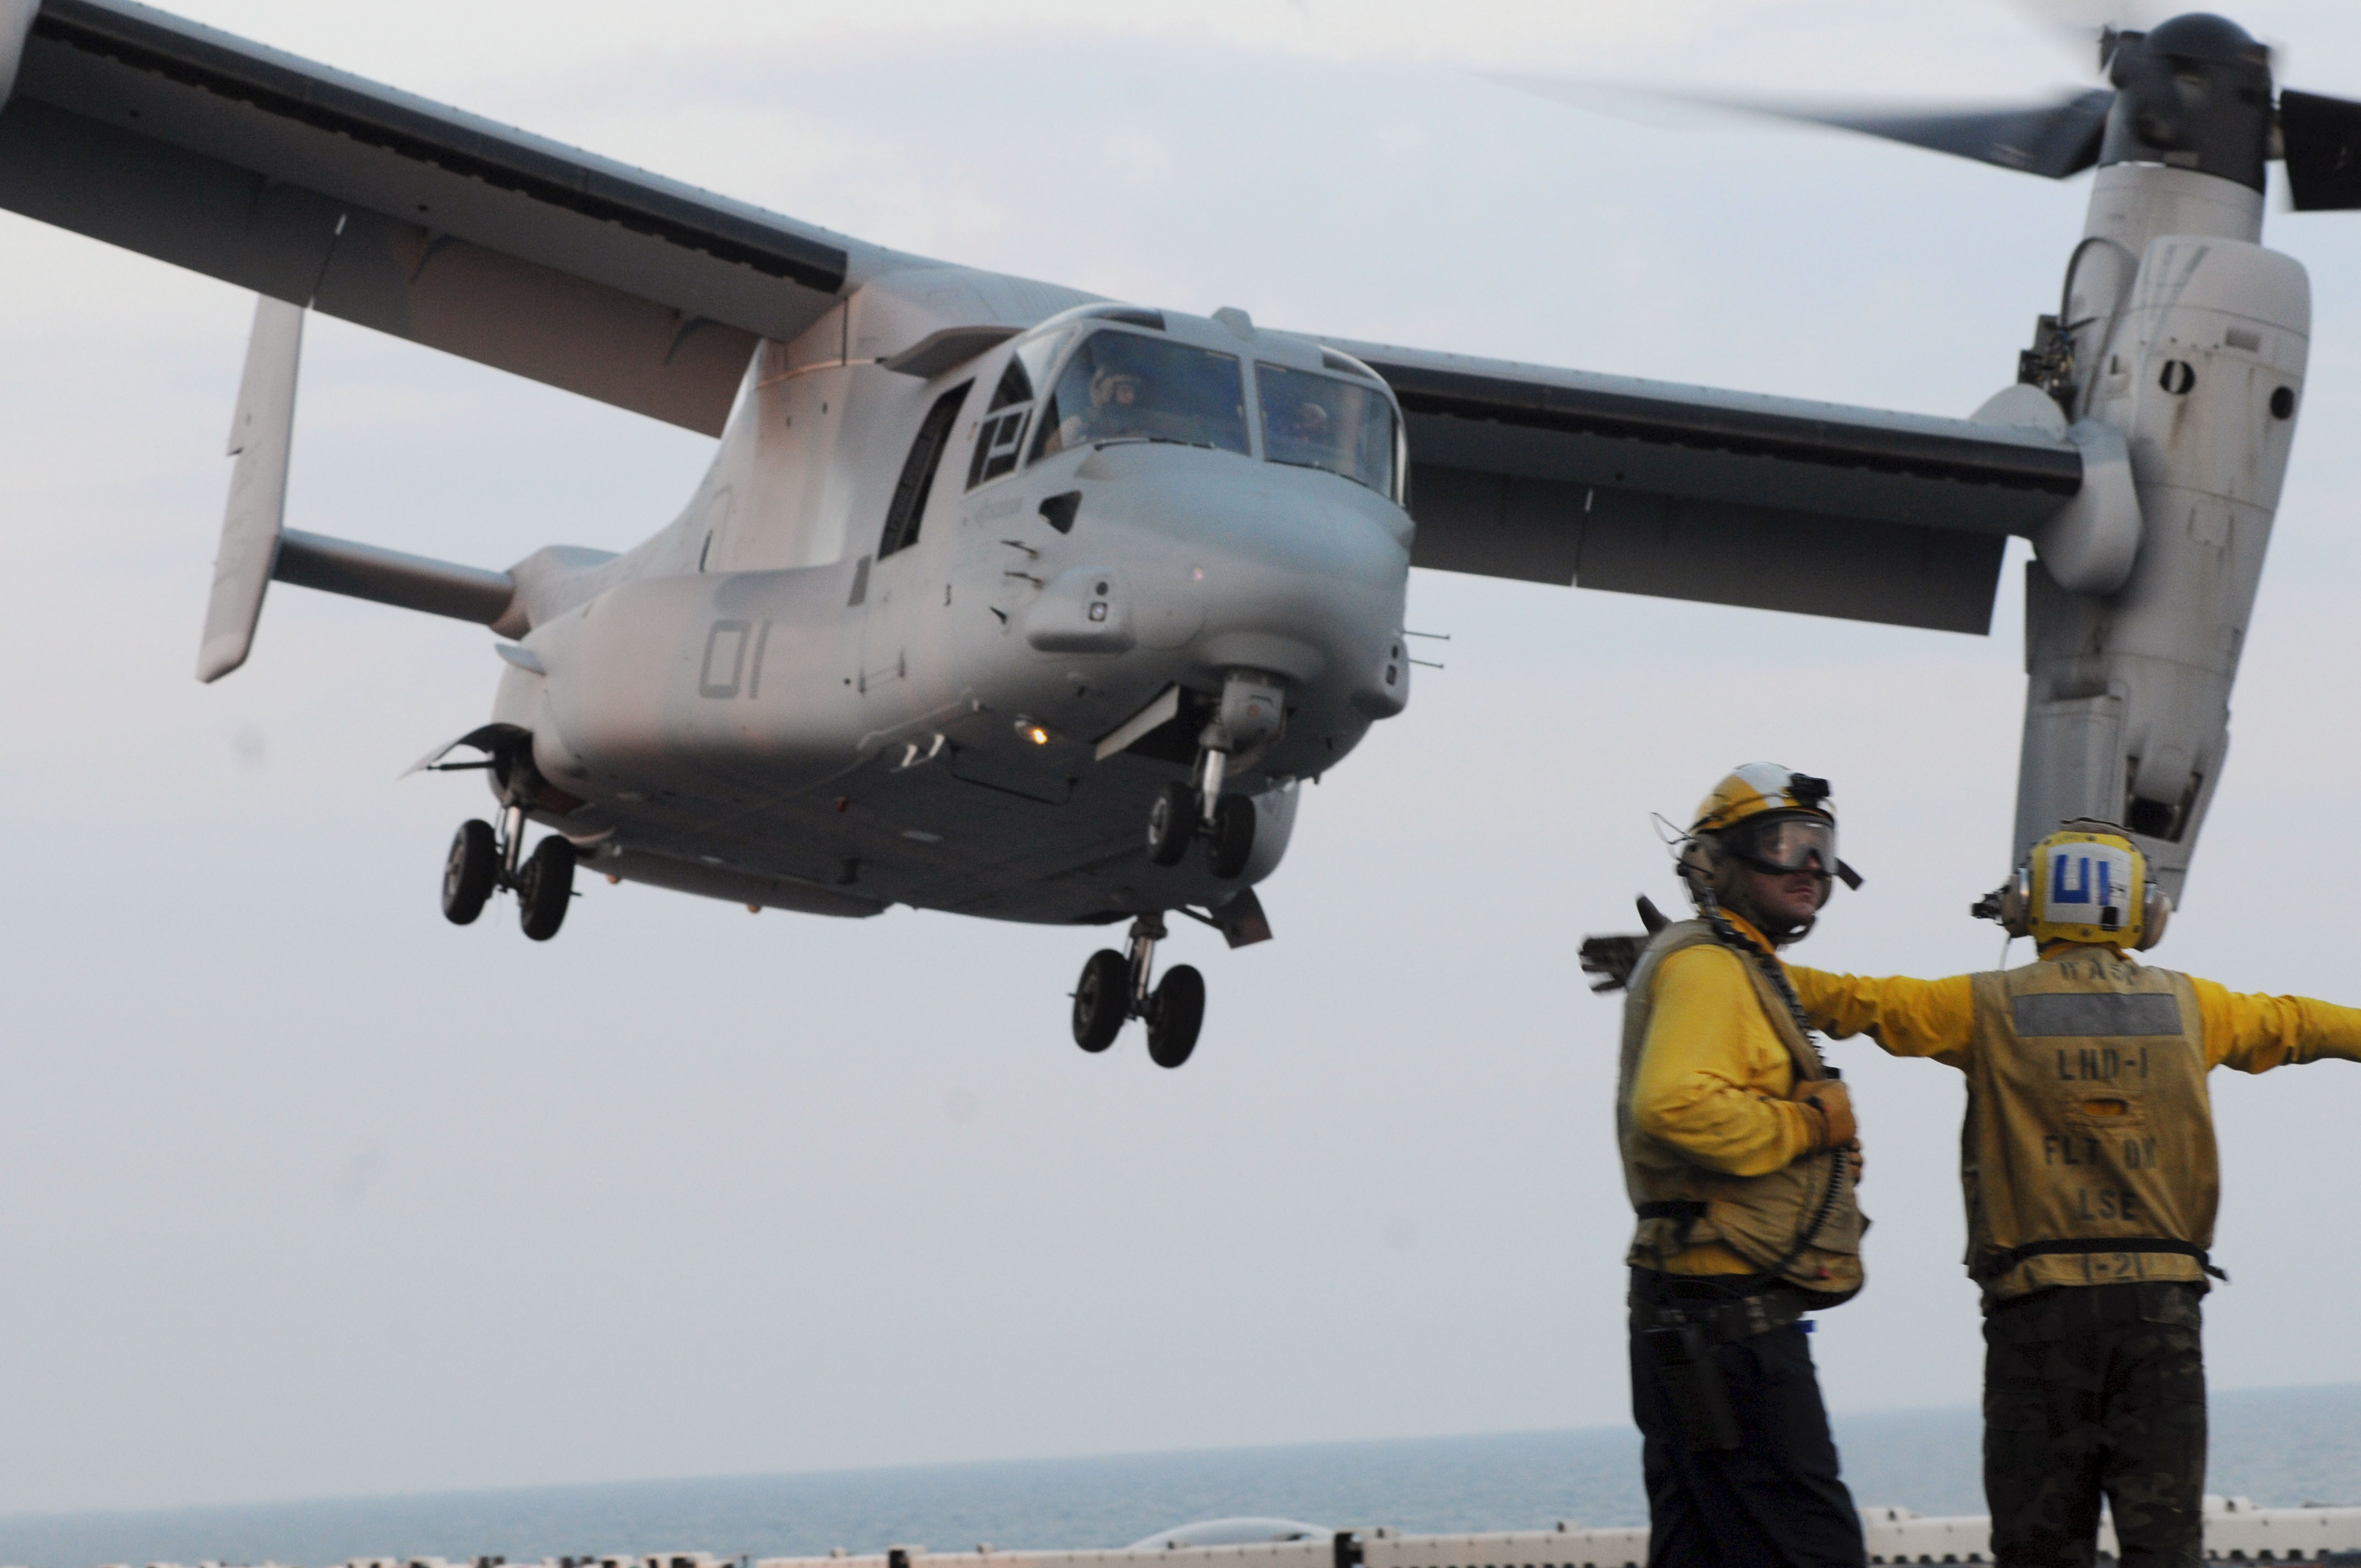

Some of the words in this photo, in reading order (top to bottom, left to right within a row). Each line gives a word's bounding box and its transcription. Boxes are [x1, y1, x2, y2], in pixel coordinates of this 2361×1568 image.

[699, 619, 772, 699] 01
[2044, 1135, 2099, 1166] FLT
[2079, 1189, 2136, 1221] LSE
